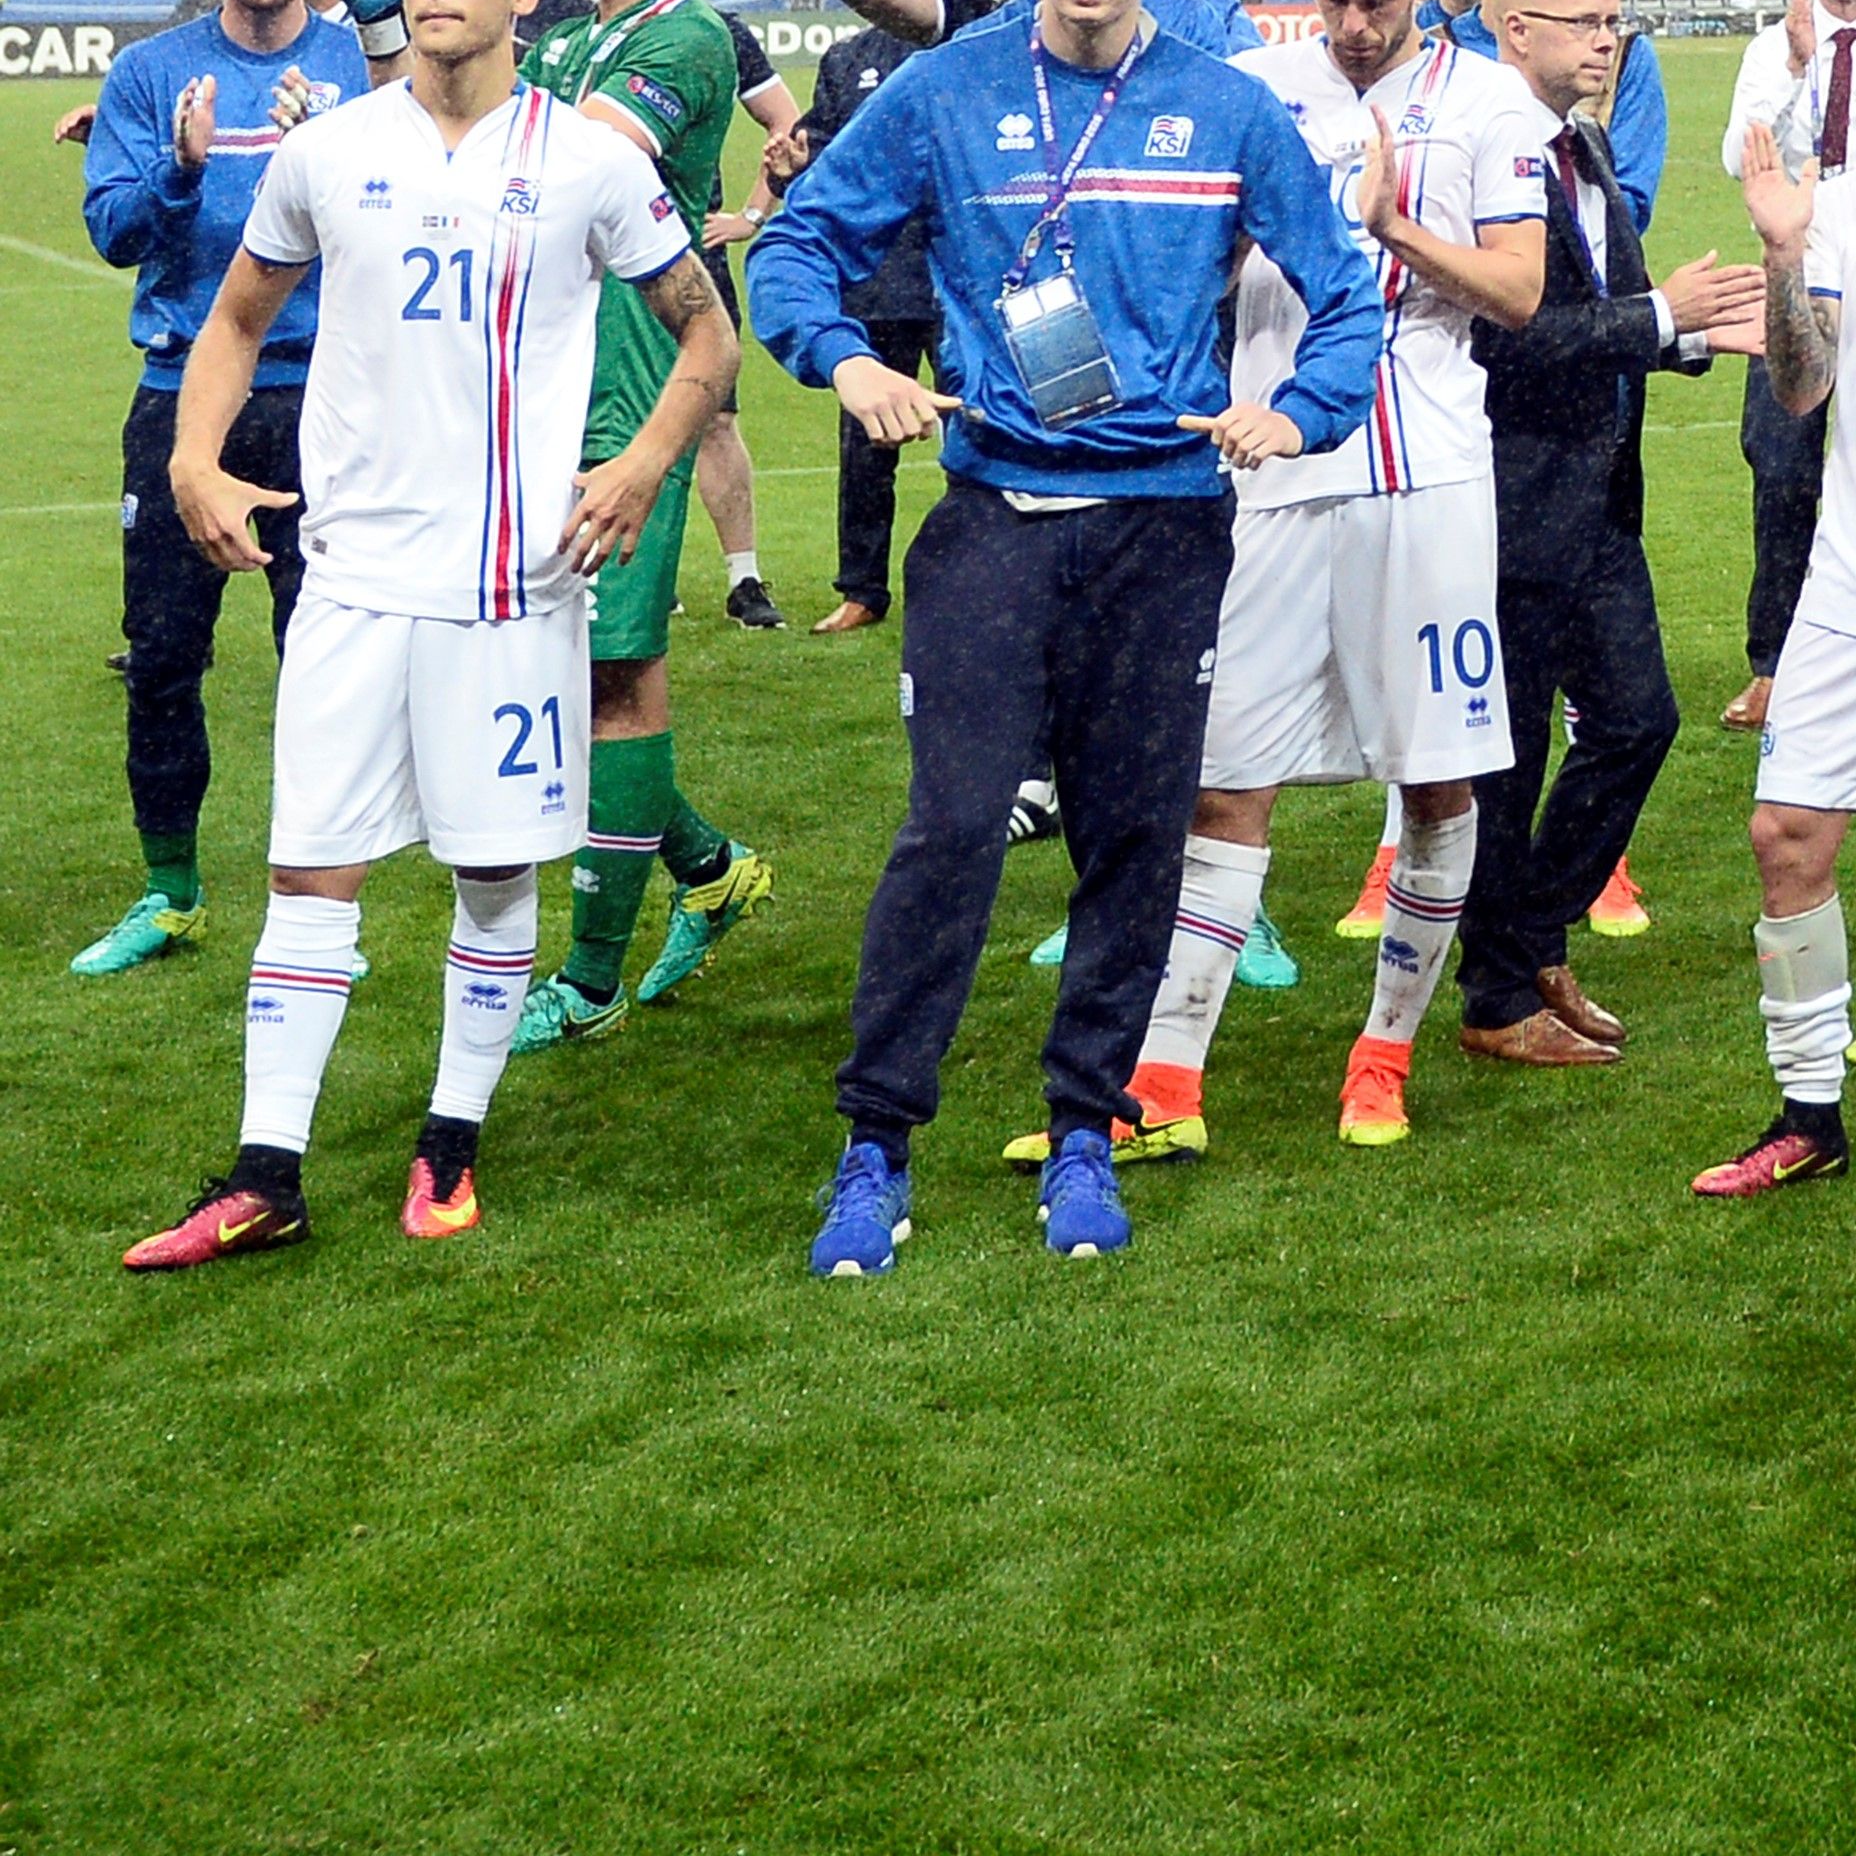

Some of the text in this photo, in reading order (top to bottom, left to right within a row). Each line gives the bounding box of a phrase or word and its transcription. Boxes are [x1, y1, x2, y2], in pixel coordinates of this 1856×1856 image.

[0, 24, 114, 74] CAR
[401, 247, 474, 322] 21
[1416, 617, 1495, 694] 10
[493, 694, 564, 777] 21
